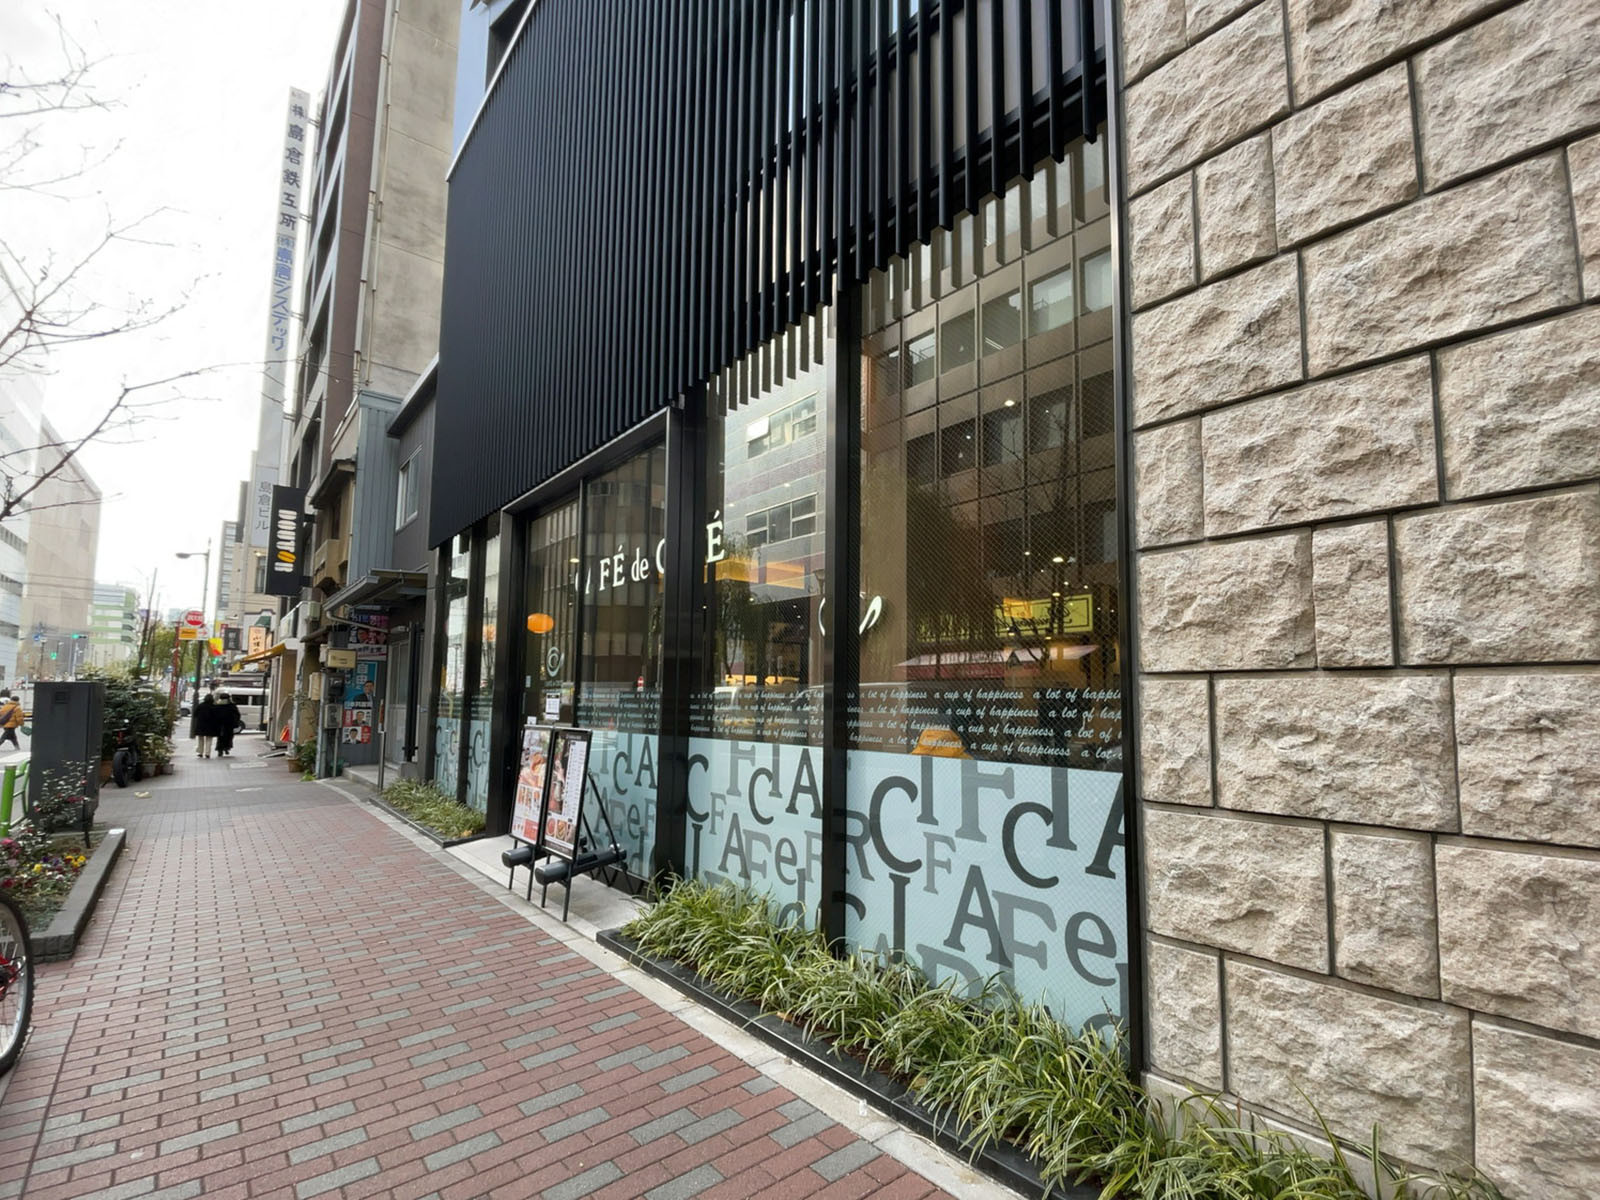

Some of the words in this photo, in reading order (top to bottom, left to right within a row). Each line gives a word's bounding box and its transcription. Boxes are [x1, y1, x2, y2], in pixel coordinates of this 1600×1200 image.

[256, 481, 271, 530] 島倉ビル
[273, 508, 297, 573] DOUTOR
[631, 547, 649, 582] de
[868, 690, 878, 699] lot
[880, 690, 888, 702] of
[890, 689, 928, 701] happiness
[944, 692, 960, 702] cup
[963, 689, 973, 703] of
[976, 688, 1024, 701] happiness
[1046, 688, 1060, 699] lot
[1066, 687, 1077, 702] of
[877, 704, 887, 713] lot
[890, 705, 898, 716] of
[901, 704, 938, 716] happiness
[956, 707, 971, 718] cup
[976, 706, 986, 719] of
[990, 705, 1039, 719] happiness
[1062, 707, 1077, 718] lot
[1082, 707, 1095, 722] of
[887, 720, 897, 729] lot
[900, 720, 908, 732] of
[911, 720, 950, 731] happiness
[969, 725, 984, 735] cup
[989, 723, 999, 737] of
[1003, 723, 1054, 737] happiness
[1078, 726, 1094, 739] lot
[1099, 727, 1112, 743] of
[897, 735, 908, 744] lot
[911, 736, 919, 748] of
[981, 742, 997, 753] cup
[1003, 741, 1013, 755] of
[1018, 741, 1071, 757] happiness
[1095, 747, 1112, 759] lot
[634, 736, 657, 789] A
[785, 748, 823, 819] A
[627, 804, 640, 839] e
[748, 767, 774, 825] C
[718, 813, 750, 880] A
[869, 776, 922, 873] C
[1002, 802, 1059, 889] C
[775, 837, 797, 885] e
[923, 832, 957, 894] F
[943, 864, 1014, 969] A
[1064, 911, 1118, 987] e
